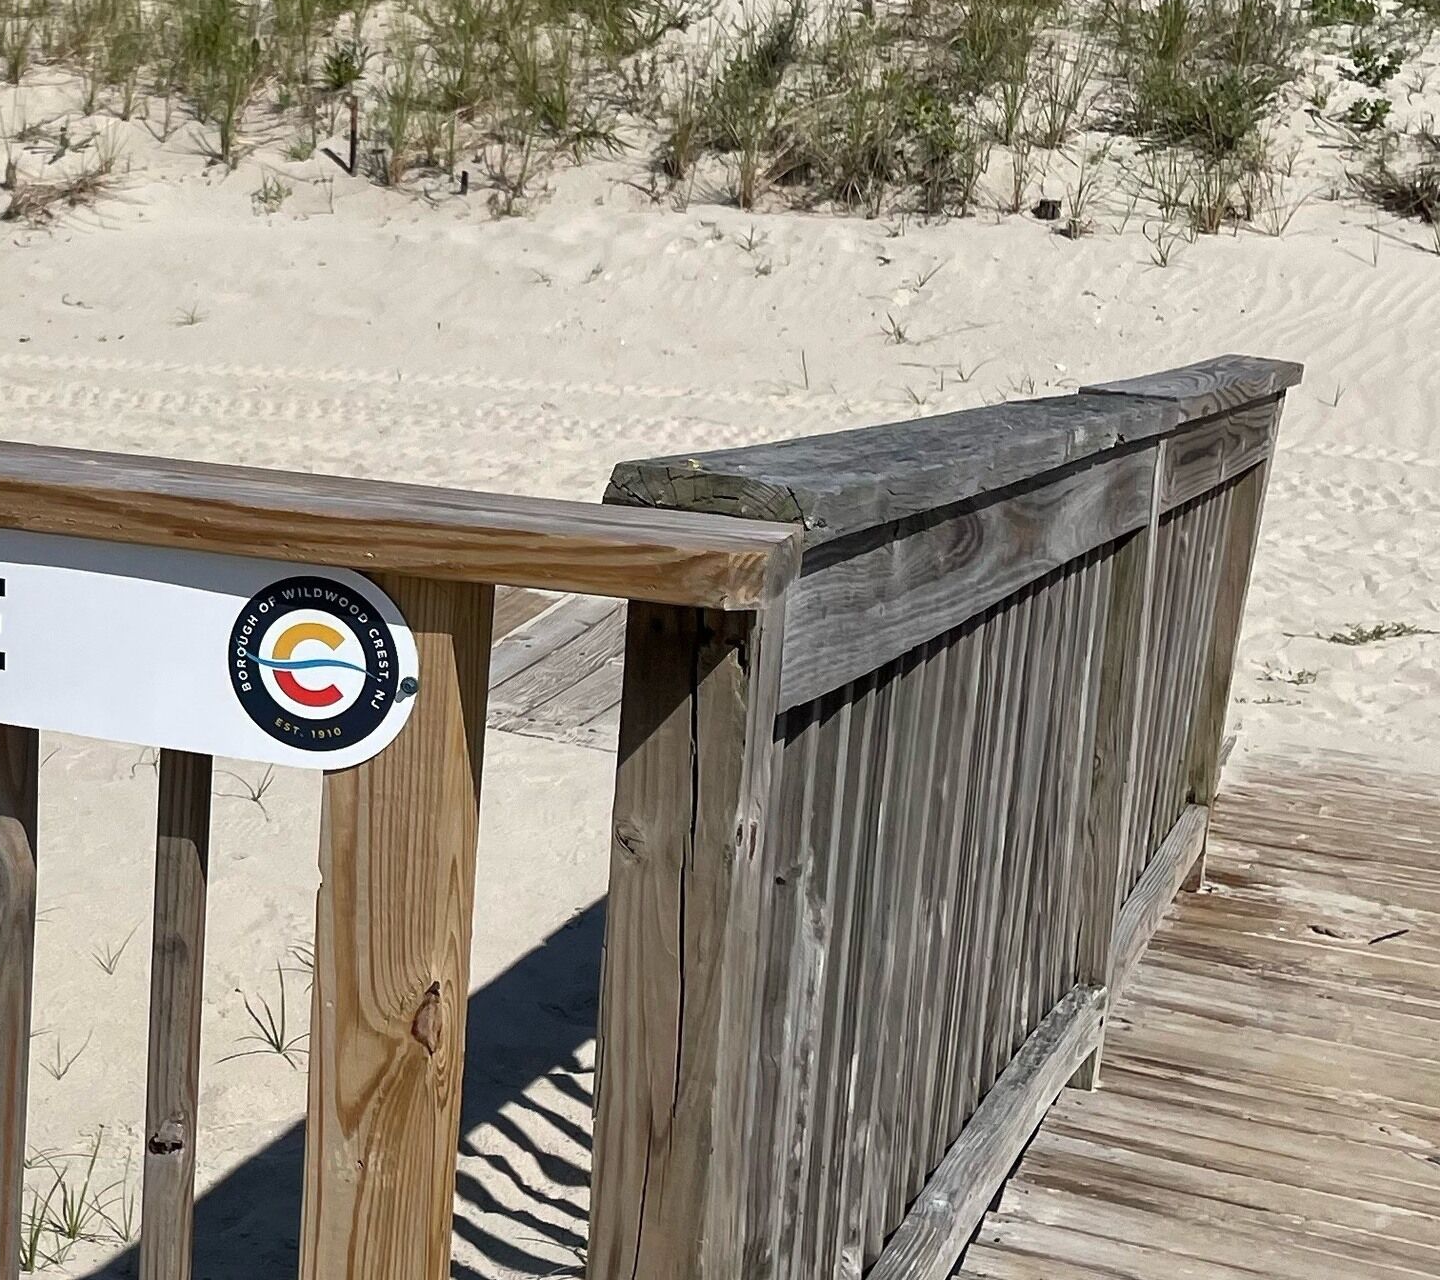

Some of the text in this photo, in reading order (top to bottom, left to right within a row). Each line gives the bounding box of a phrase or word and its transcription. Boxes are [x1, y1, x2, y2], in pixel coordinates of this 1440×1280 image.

[236, 587, 390, 710] BOROUGH OF WILDWOOD CREST, NJ
[274, 717, 342, 739] EST. 1910
